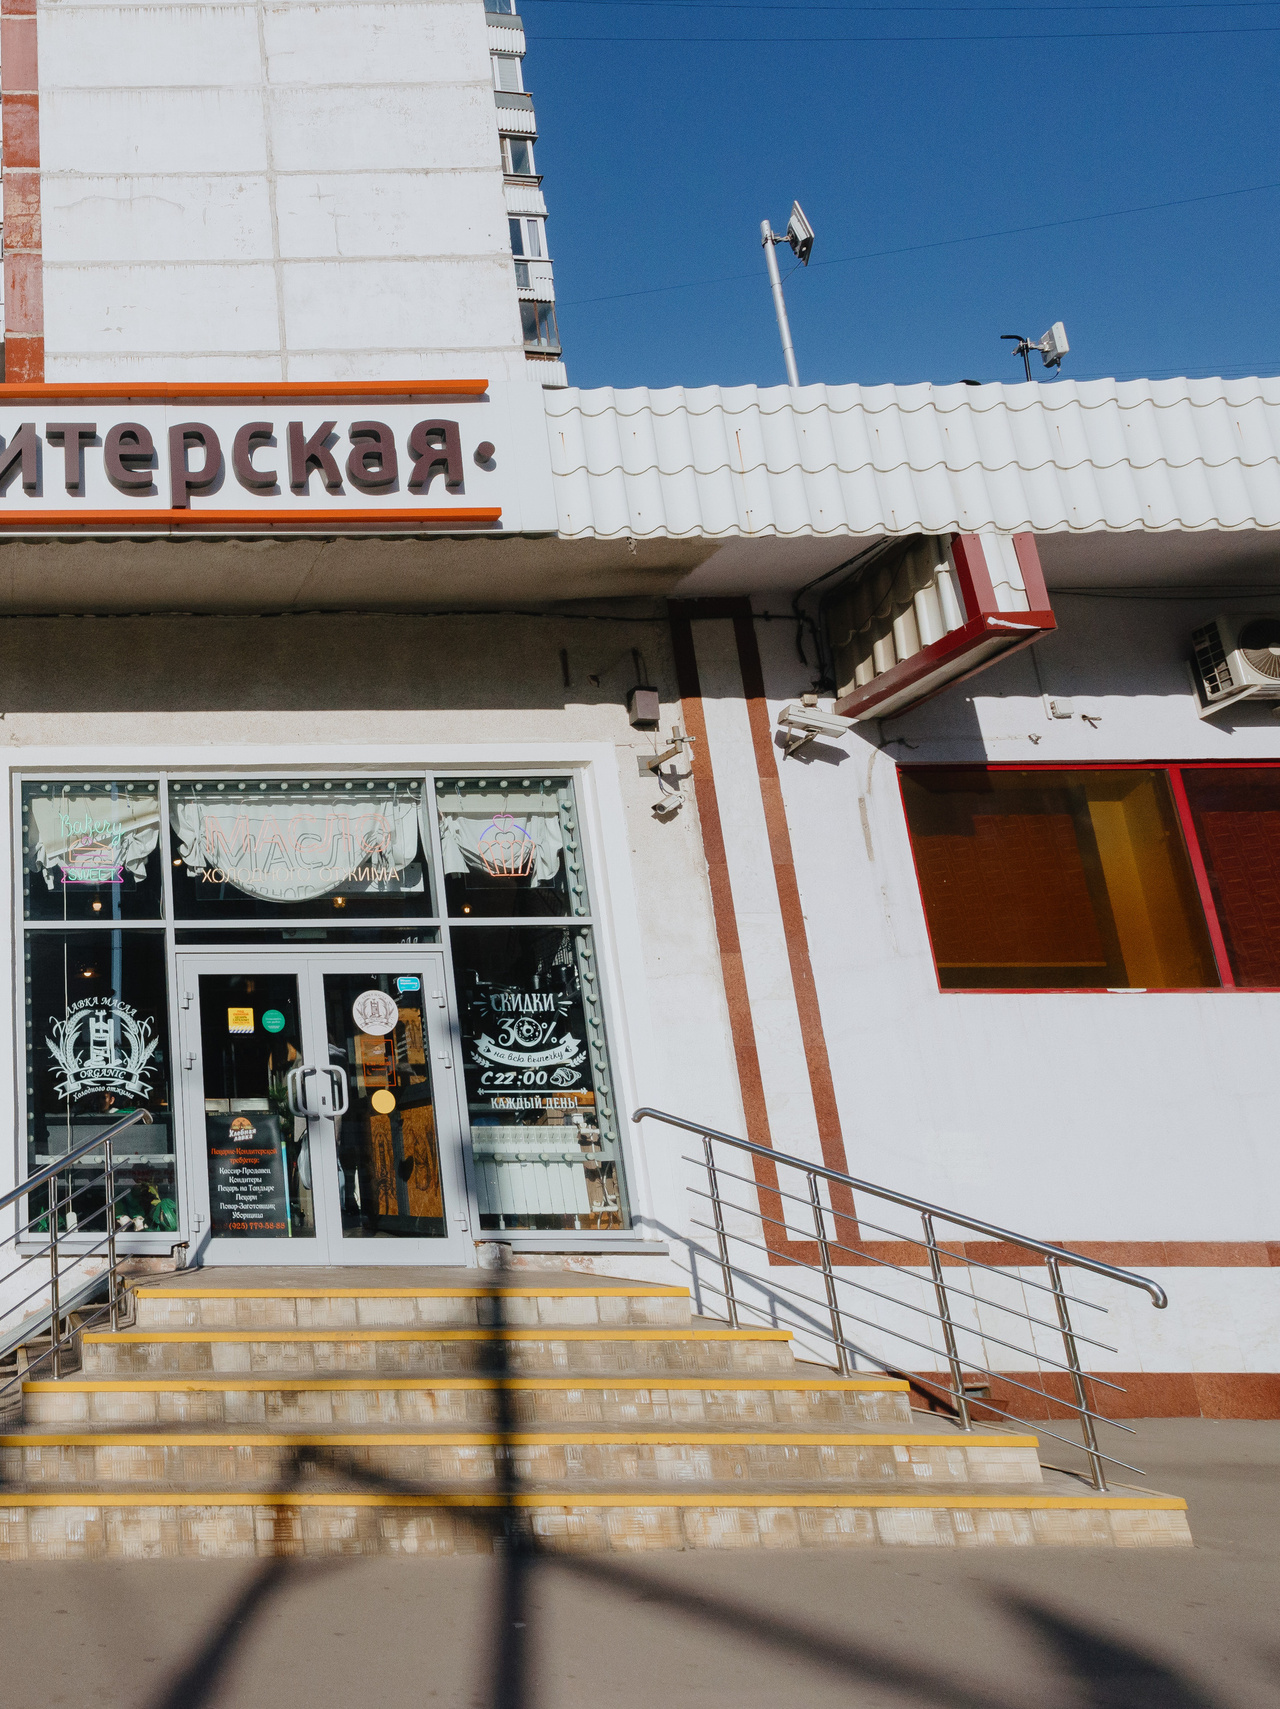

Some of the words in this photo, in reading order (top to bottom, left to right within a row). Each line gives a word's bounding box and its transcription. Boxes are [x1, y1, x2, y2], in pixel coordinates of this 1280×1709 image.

[59, 813, 126, 846] Bakery
[205, 813, 391, 853] МАСЛО
[68, 867, 117, 881] SWEET
[201, 867, 311, 883] ХОЛОДНОГО
[319, 866, 400, 883] ОТЖИМА
[66, 996, 99, 1017] ЛАВКА
[101, 996, 138, 1017] МАСЛА
[489, 993, 556, 1014] СКИДКИ
[493, 1050, 506, 1059] на
[507, 1052, 524, 1063] всю
[527, 1050, 564, 1063] выпечку
[79, 1068, 126, 1079] ORGANIC
[494, 1071, 548, 1086] 22:00
[73, 1086, 105, 1102] Холодного
[490, 1095, 543, 1110] КАЖДЫЙ
[544, 1096, 579, 1110] ДЕНЬ!
